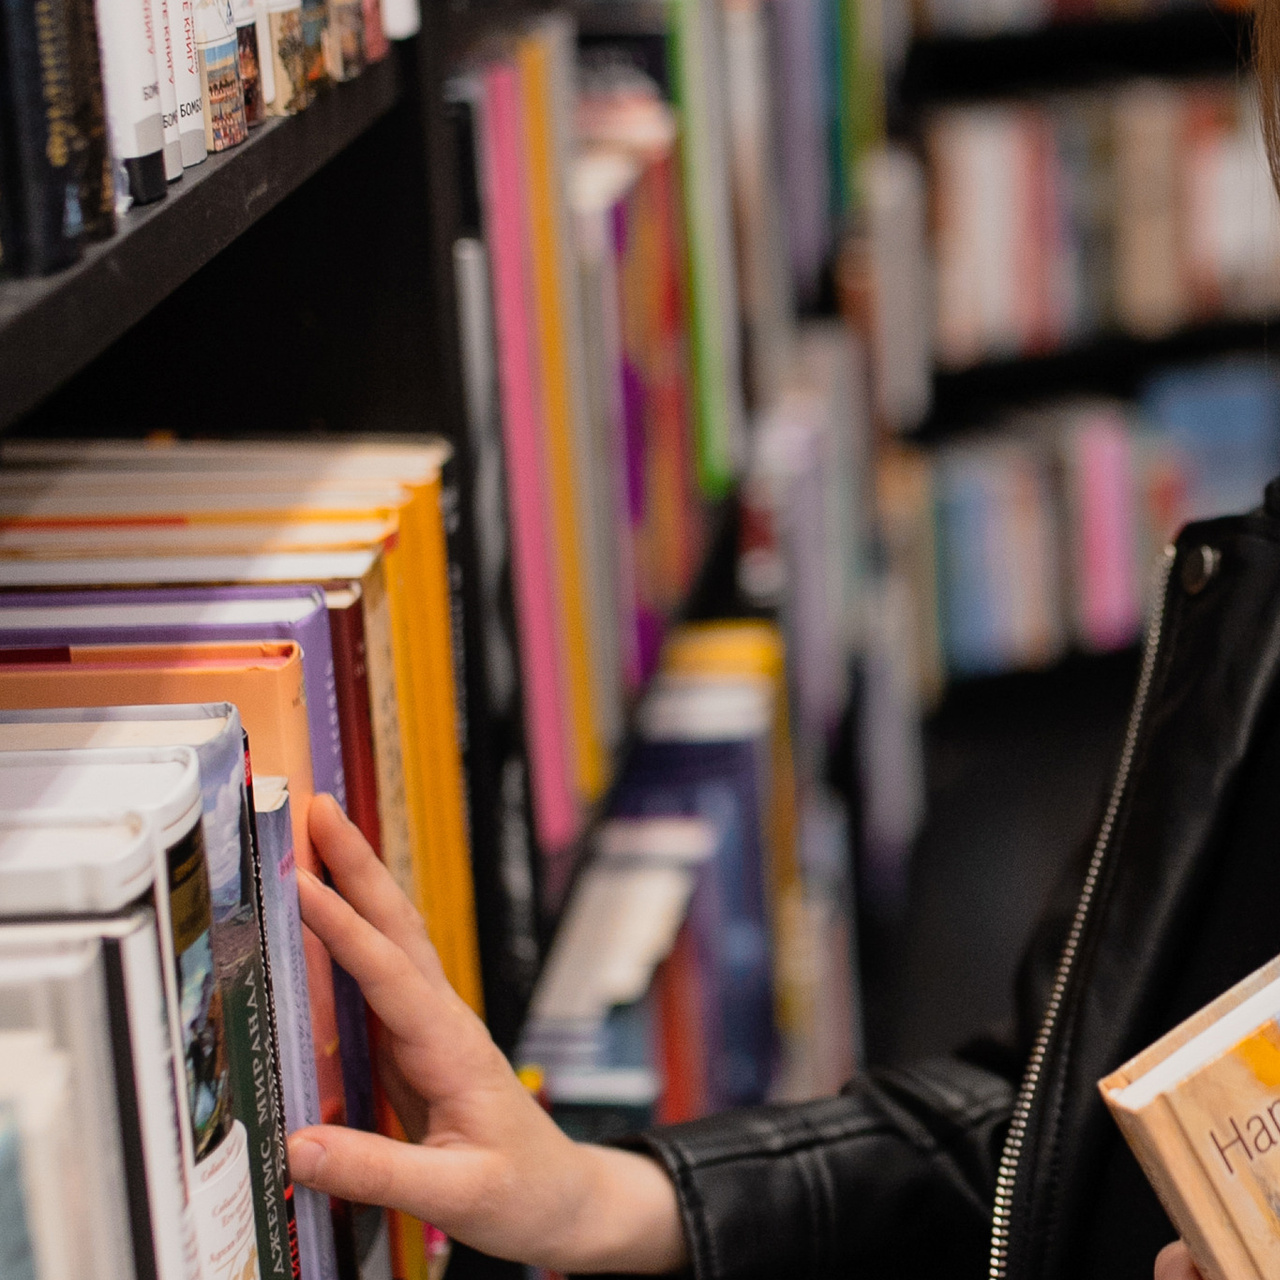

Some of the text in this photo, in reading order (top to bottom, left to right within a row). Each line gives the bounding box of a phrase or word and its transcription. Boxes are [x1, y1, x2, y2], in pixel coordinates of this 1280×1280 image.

[184, 17, 195, 76] КНИГУ
[244, 967, 269, 1126] МИРАНДА
[260, 1136, 285, 1277] ДЖЕЙМС
